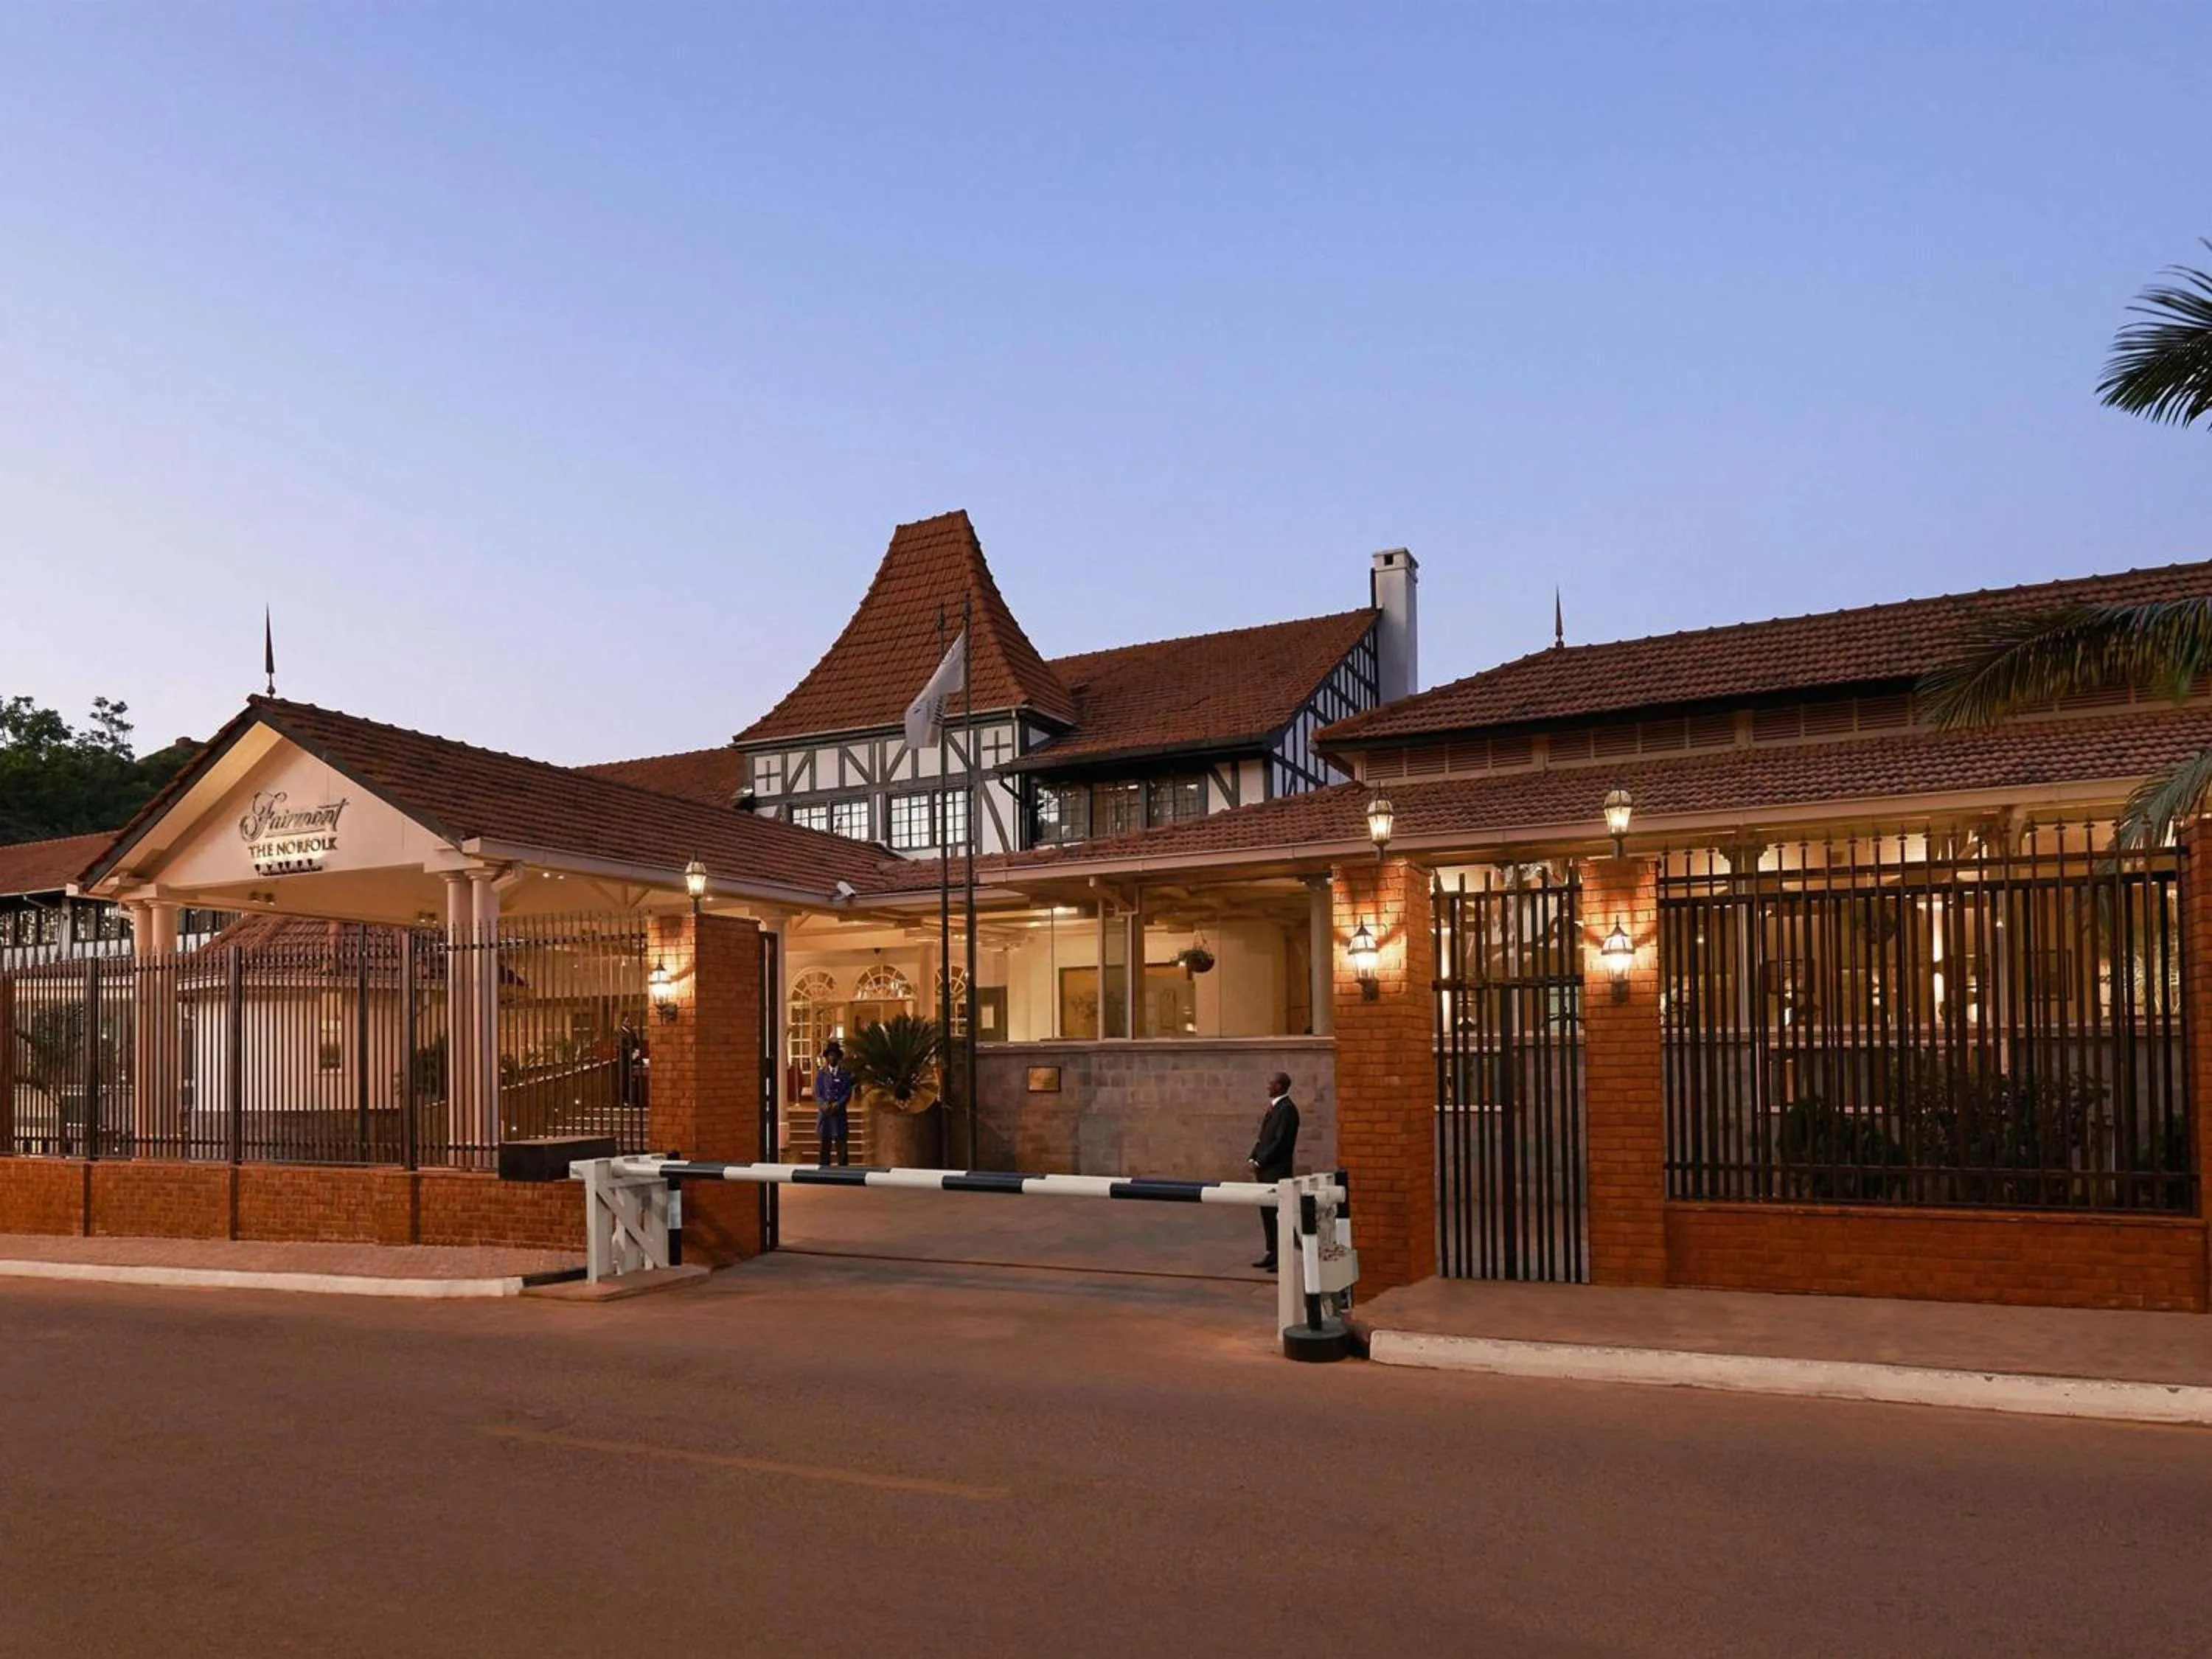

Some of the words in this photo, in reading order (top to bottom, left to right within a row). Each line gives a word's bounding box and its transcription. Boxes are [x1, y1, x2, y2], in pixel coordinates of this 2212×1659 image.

[240, 791, 349, 842] Fairmont
[248, 843, 274, 858] THE
[276, 838, 338, 855] NORFOLK
